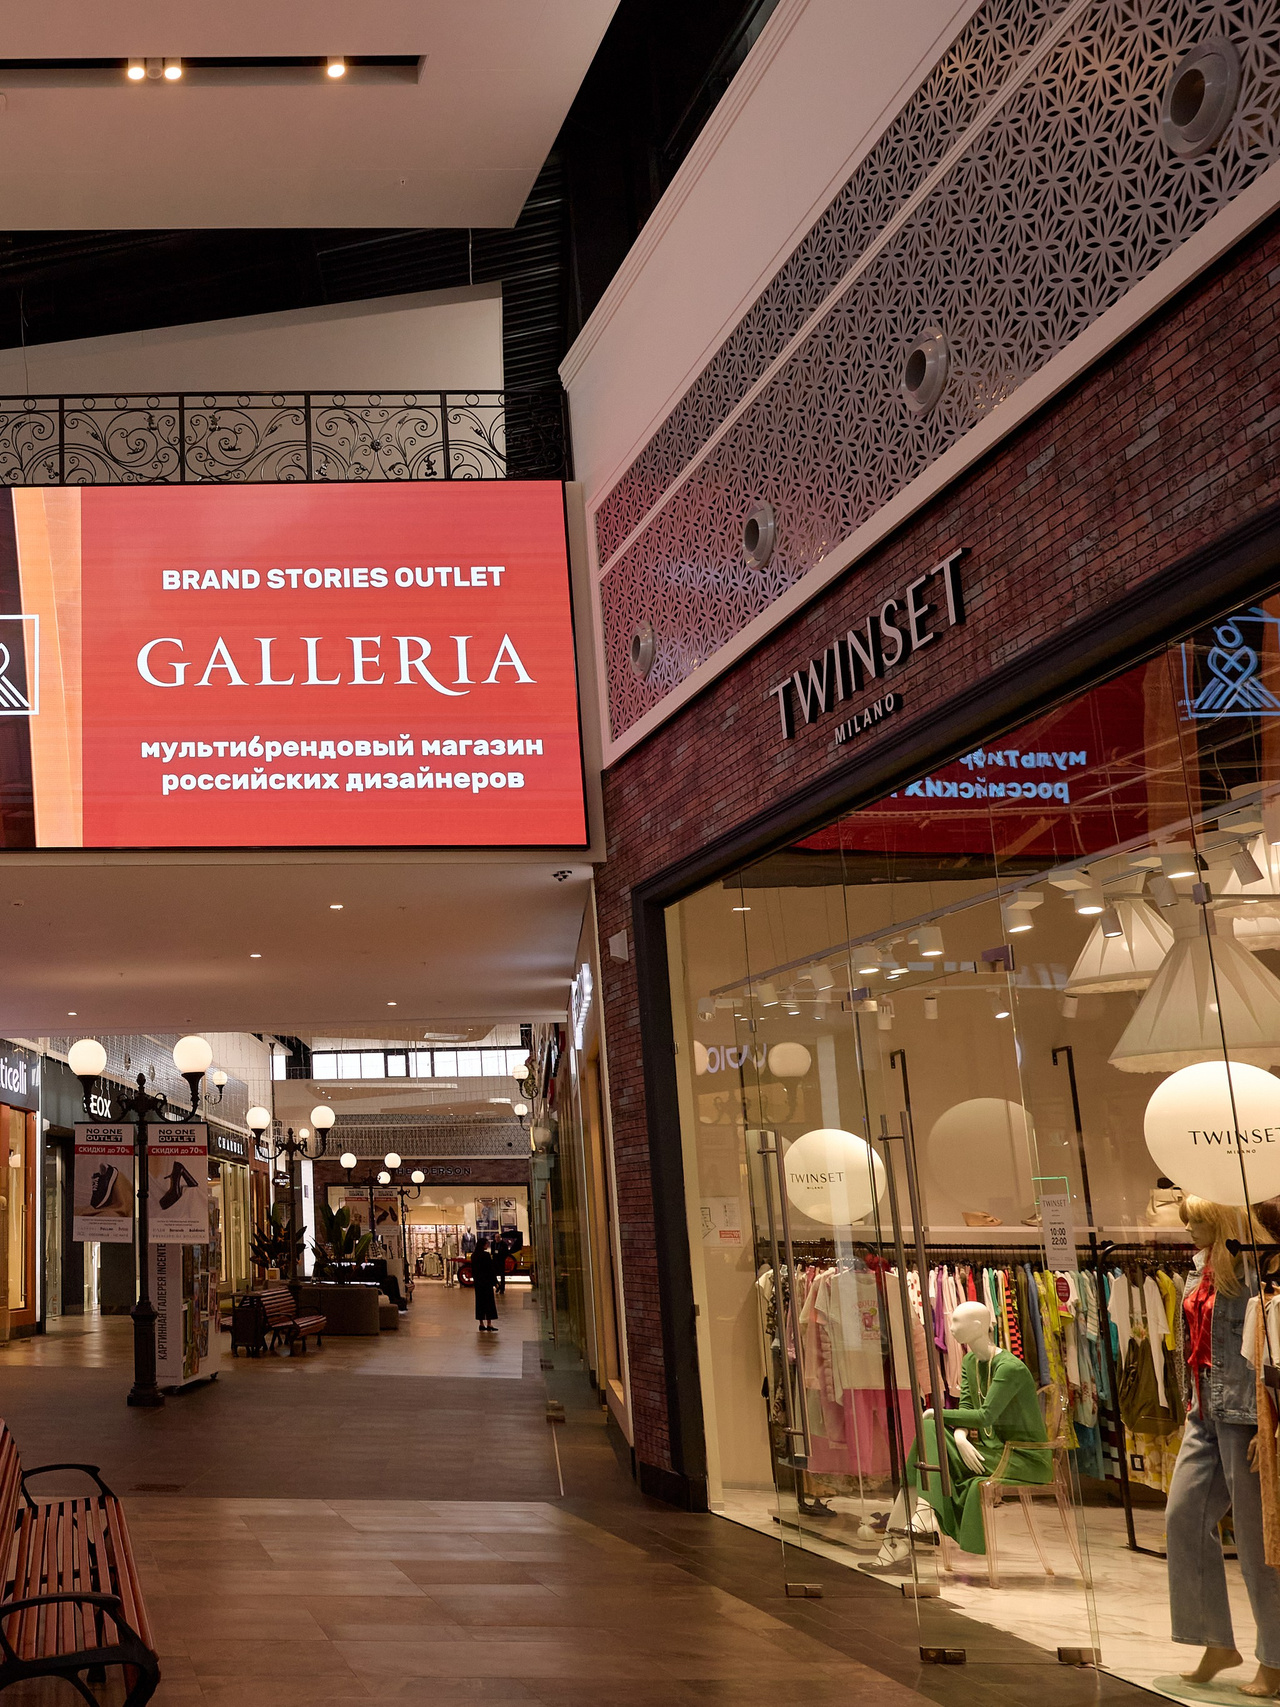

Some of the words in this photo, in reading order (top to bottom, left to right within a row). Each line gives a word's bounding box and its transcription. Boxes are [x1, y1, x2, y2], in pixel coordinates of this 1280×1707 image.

[162, 568, 261, 591] BRAND
[266, 567, 389, 590] STORIES
[394, 565, 506, 589] OUTLET
[769, 547, 970, 740] TWINSET
[136, 632, 538, 697] GALLERIA
[834, 691, 900, 745] MILANO
[141, 734, 414, 763] мультибрендовый
[421, 737, 544, 757] магазин
[162, 766, 340, 796] российских
[345, 766, 525, 794] дизайнеров
[1187, 1127, 1280, 1146] TWINSE
[790, 1171, 844, 1183] TWINSET
[1043, 1199, 1067, 1208] TWINSET
[1050, 1228, 1066, 1236] 10:00
[1051, 1237, 1068, 1245] 22:00
[157, 1276, 167, 1311] ГАЛЕРЕЯ
[157, 1313, 168, 1360] КАРТИННАЯ
